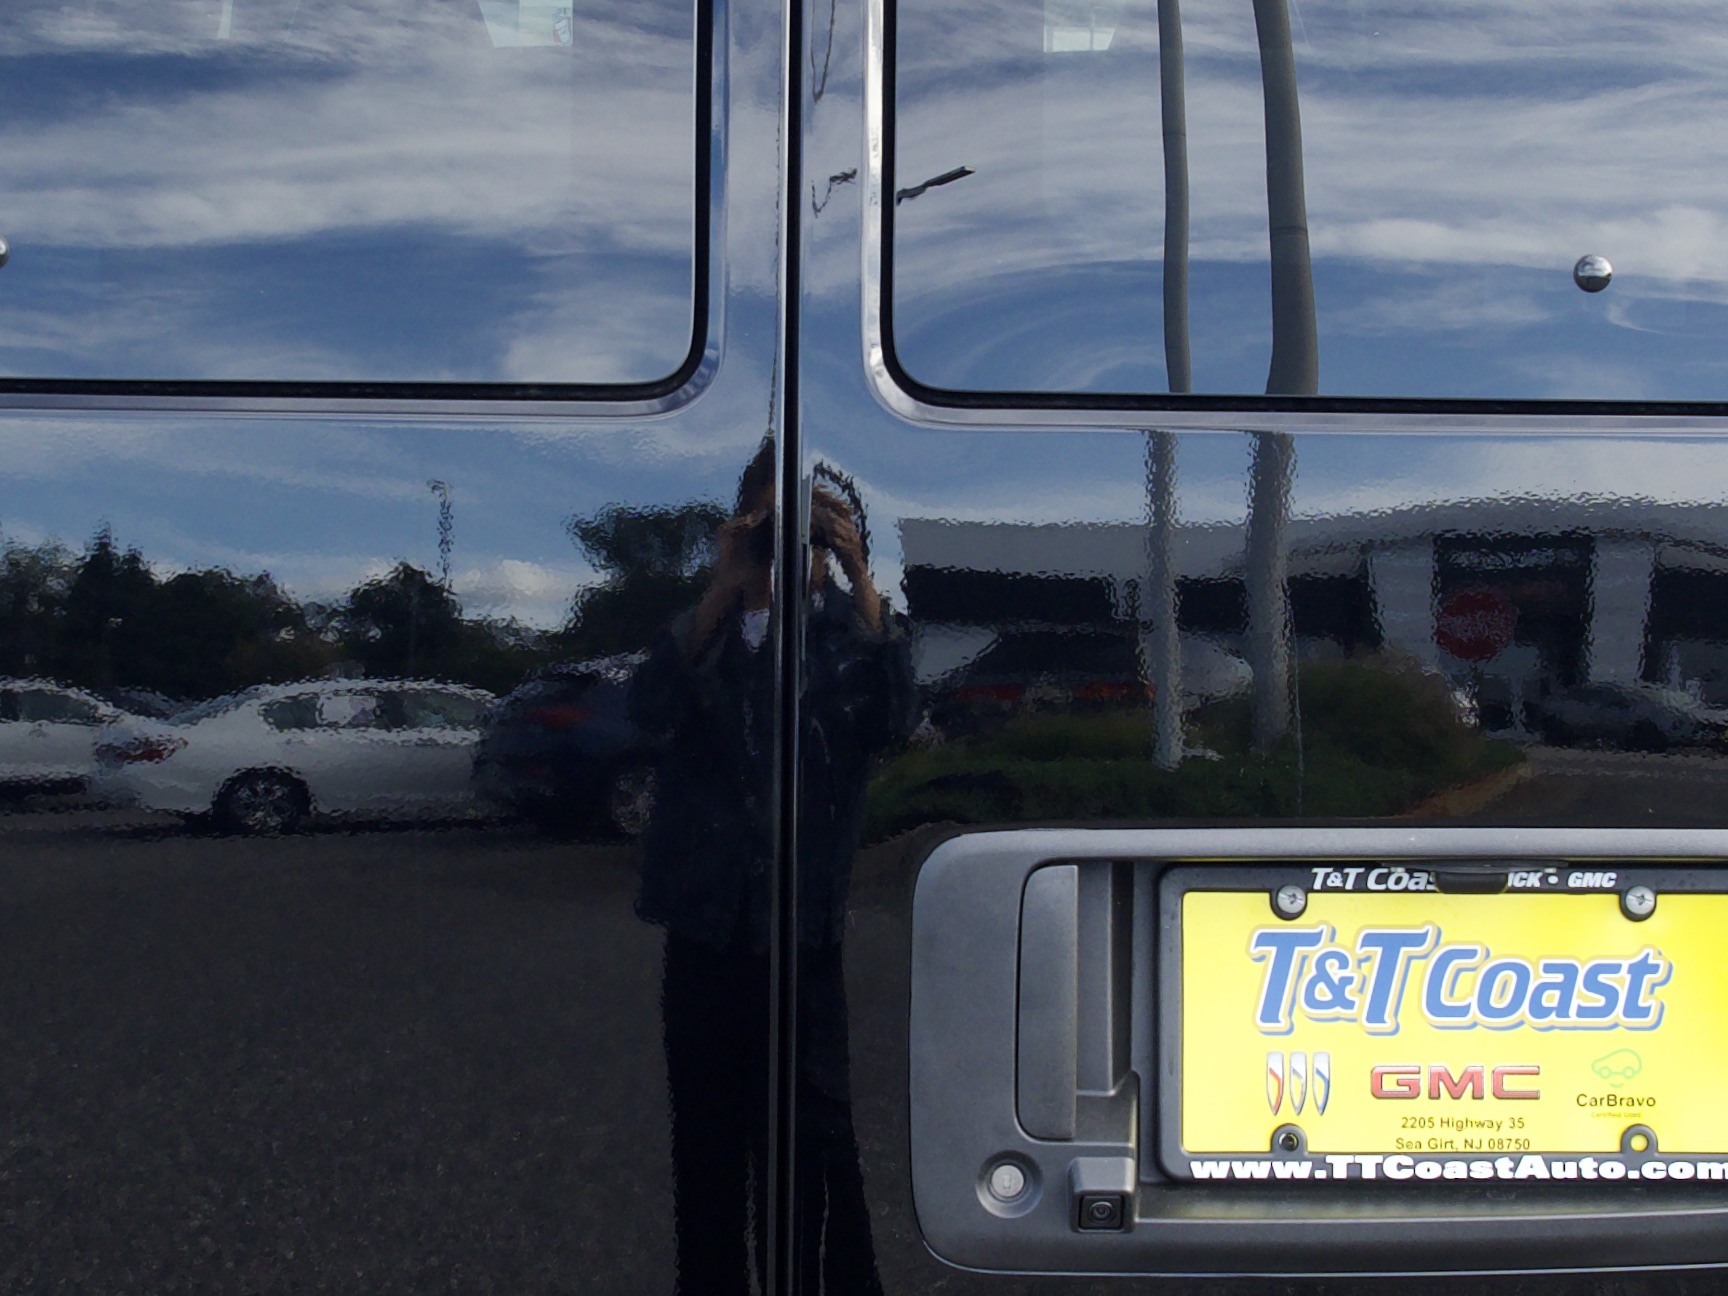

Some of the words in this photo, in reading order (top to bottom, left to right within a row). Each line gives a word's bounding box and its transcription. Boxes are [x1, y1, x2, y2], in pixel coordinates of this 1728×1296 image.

[1311, 867, 1363, 890] T&T
[1567, 871, 1617, 888] GMC
[1249, 922, 1440, 1035] T&T
[1423, 941, 1673, 1032] Coast
[1370, 1065, 1541, 1100] GMC
[1576, 1093, 1656, 1108] CarBravo
[1401, 1117, 1436, 1130] 2205
[1440, 1117, 1503, 1132] Highway
[1508, 1117, 1526, 1130] 35
[1395, 1138, 1422, 1151] Sea
[1428, 1138, 1459, 1151] Girt,
[1464, 1138, 1483, 1150] NJ
[1488, 1138, 1531, 1150] 08750
